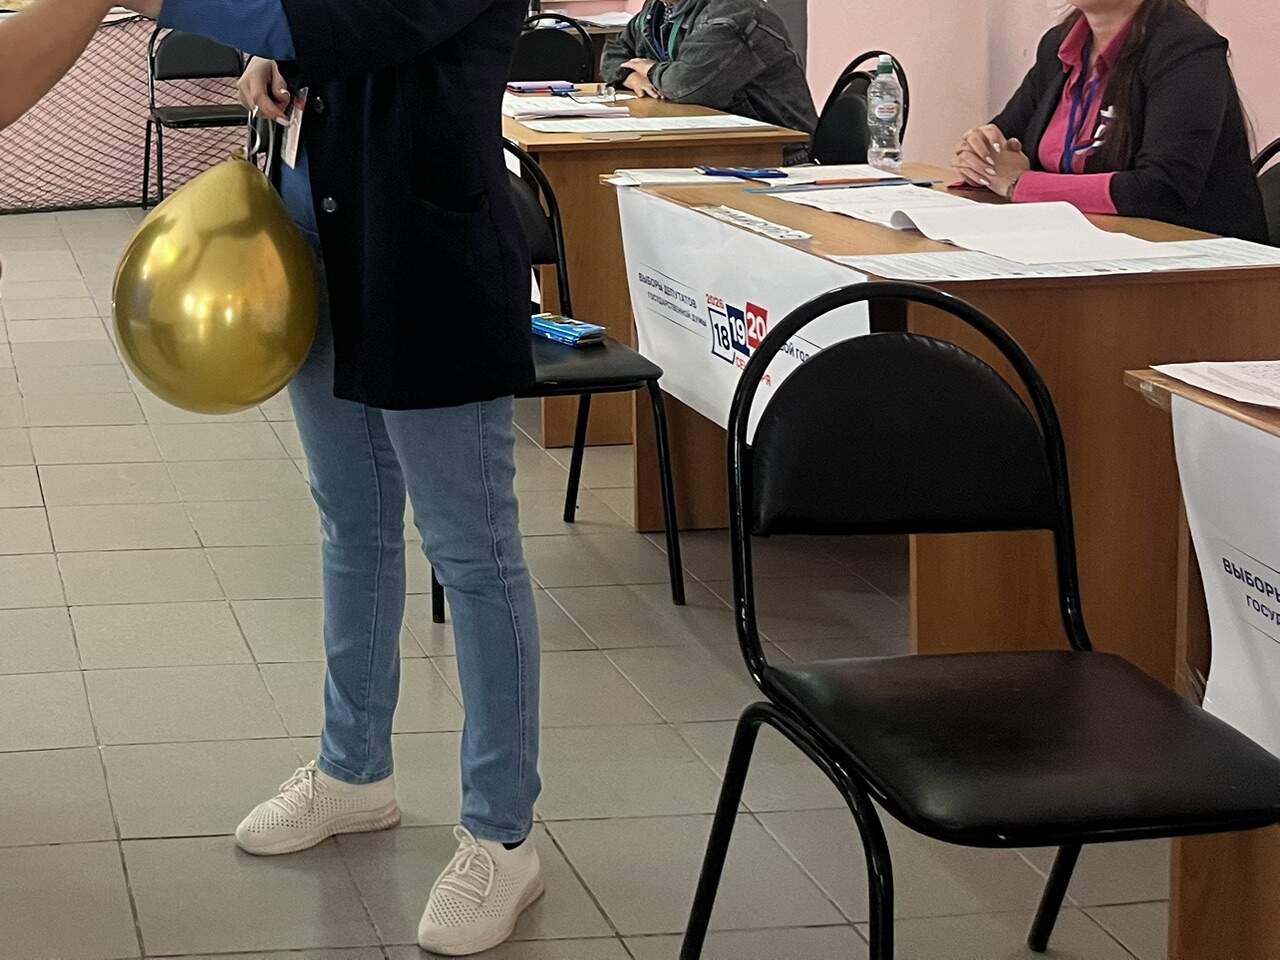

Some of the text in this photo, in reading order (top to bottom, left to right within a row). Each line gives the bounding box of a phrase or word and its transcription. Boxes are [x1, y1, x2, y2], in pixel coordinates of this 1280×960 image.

[638, 272, 697, 309] ВЫБОРЫ ДЕПУТАТОВ
[714, 312, 766, 351] 18 19 20
